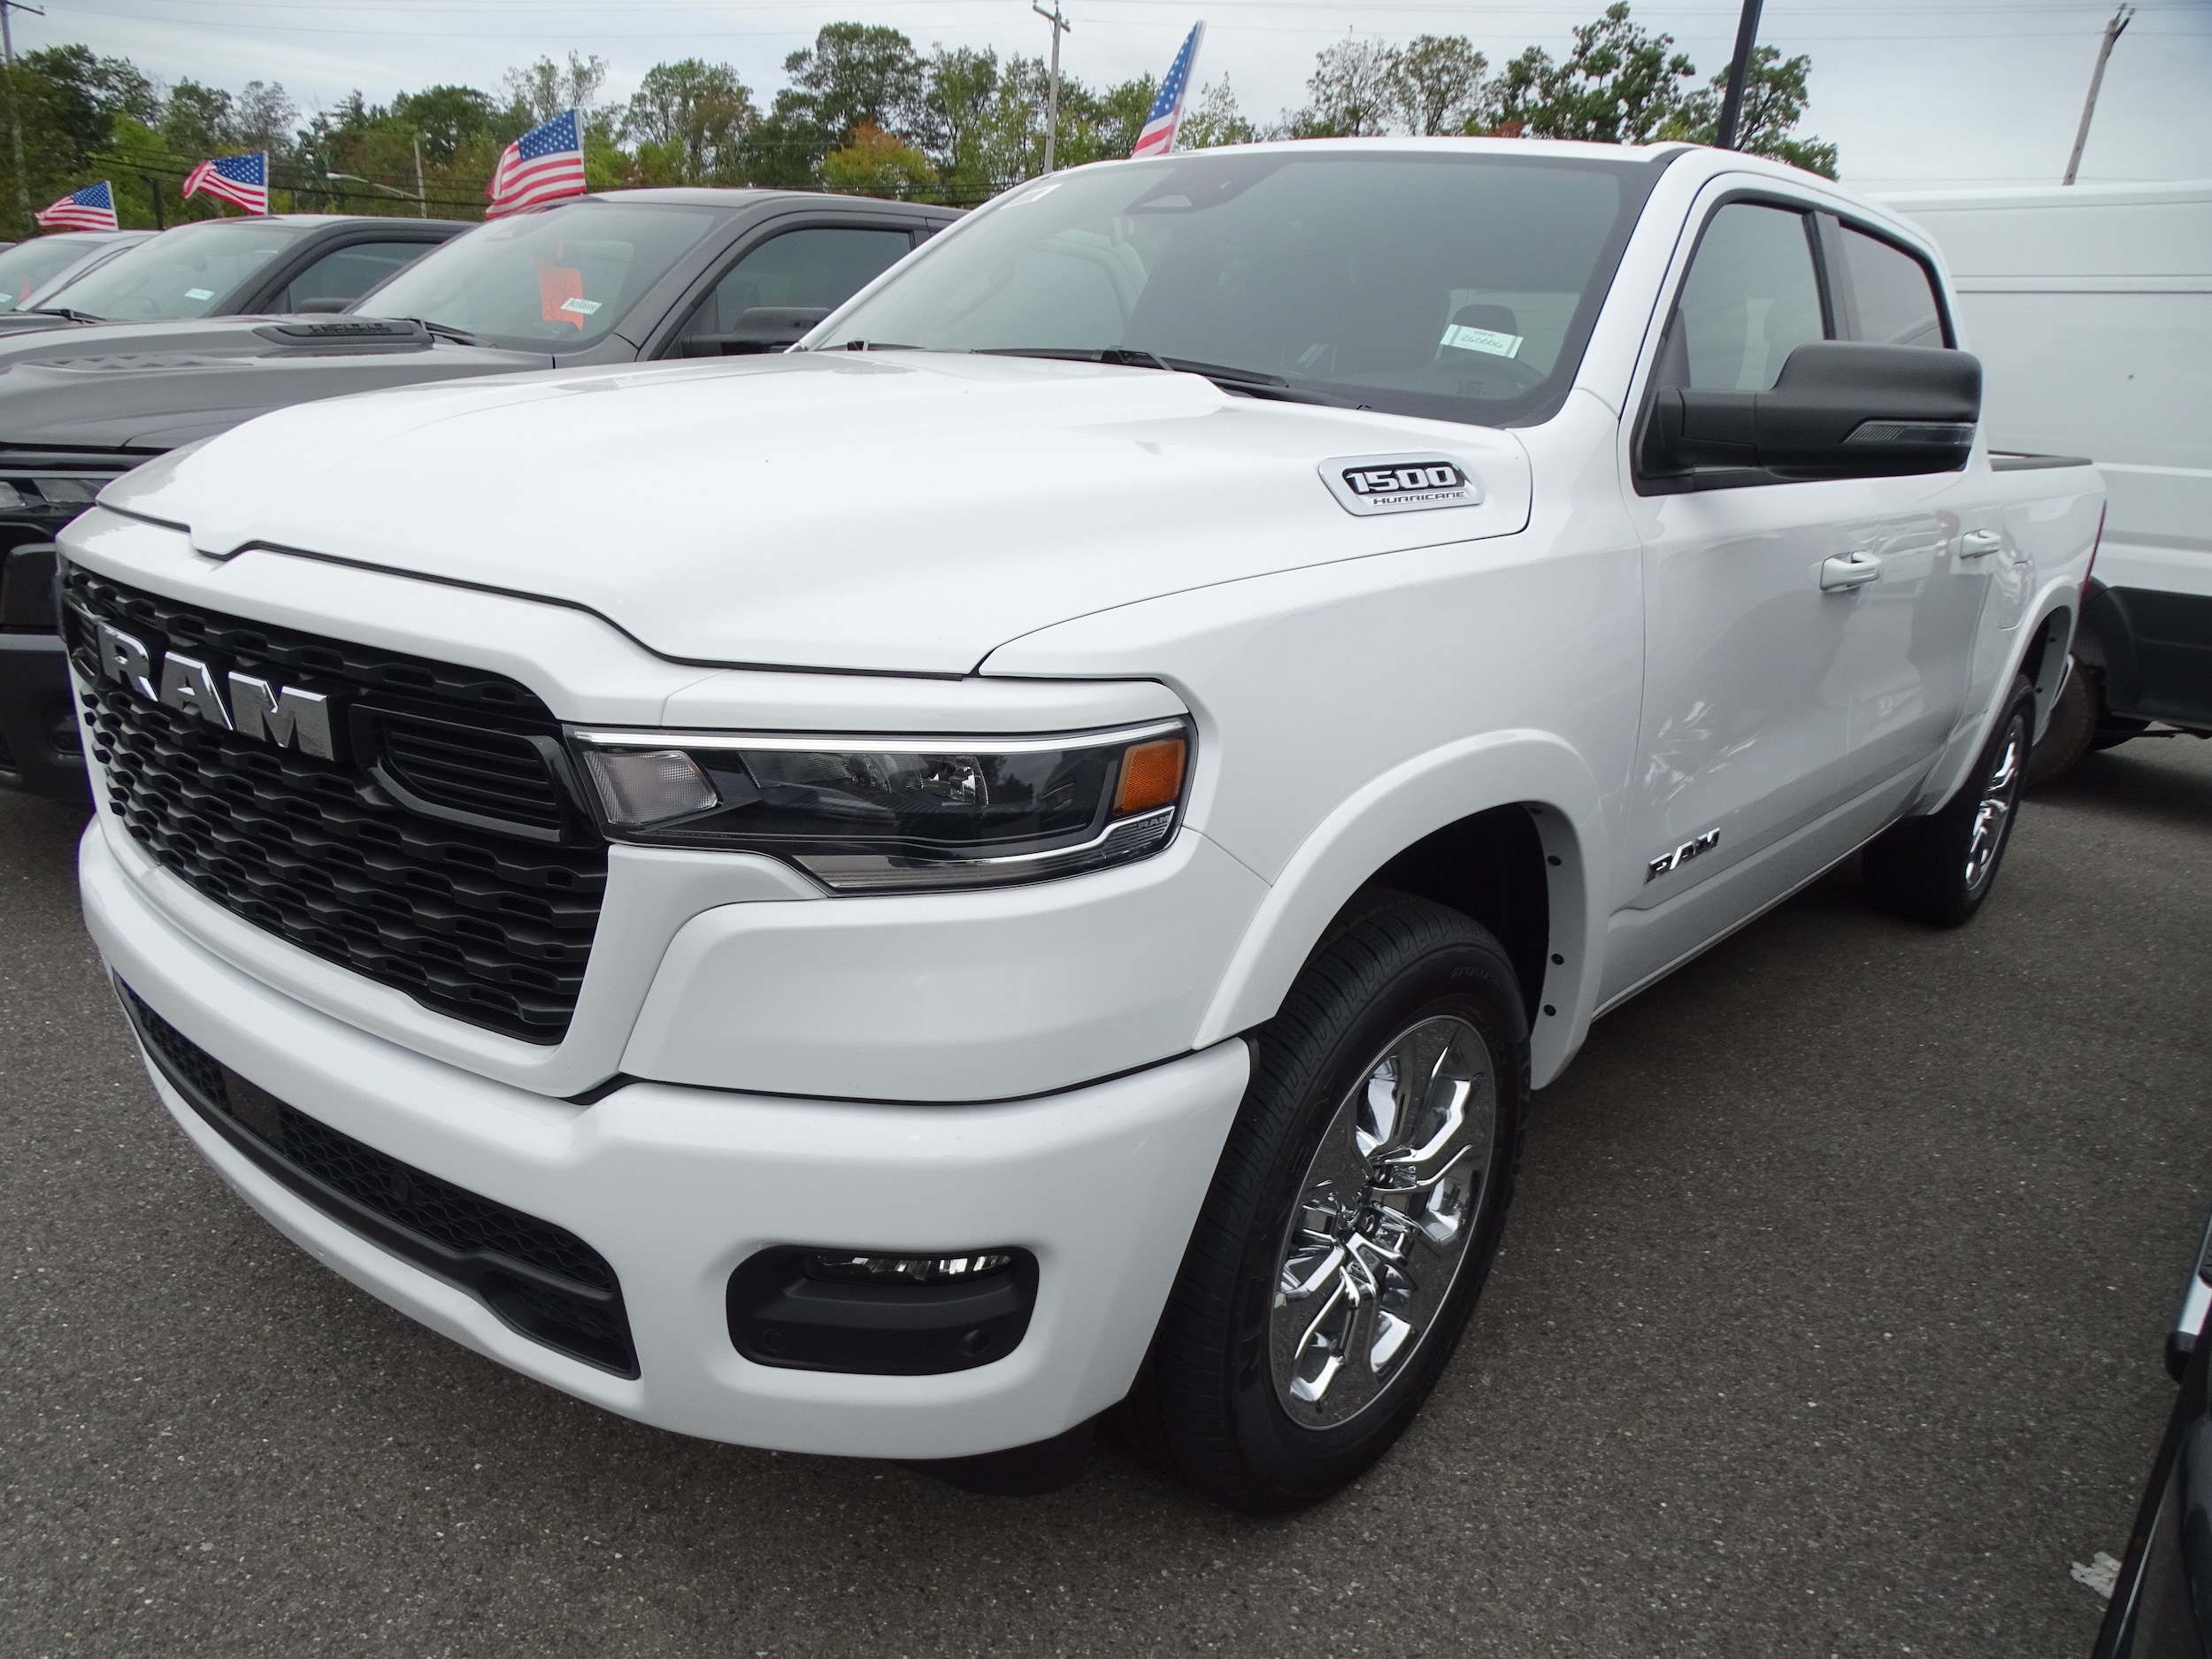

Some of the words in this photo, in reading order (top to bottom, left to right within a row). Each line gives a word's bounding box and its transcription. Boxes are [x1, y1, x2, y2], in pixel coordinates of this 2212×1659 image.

[1346, 466, 1457, 493] 1500
[1373, 491, 1466, 505] HURRICANE
[97, 621, 335, 762] RAM
[1138, 815, 1170, 829] RAM
[1643, 826, 1720, 885] RAM
